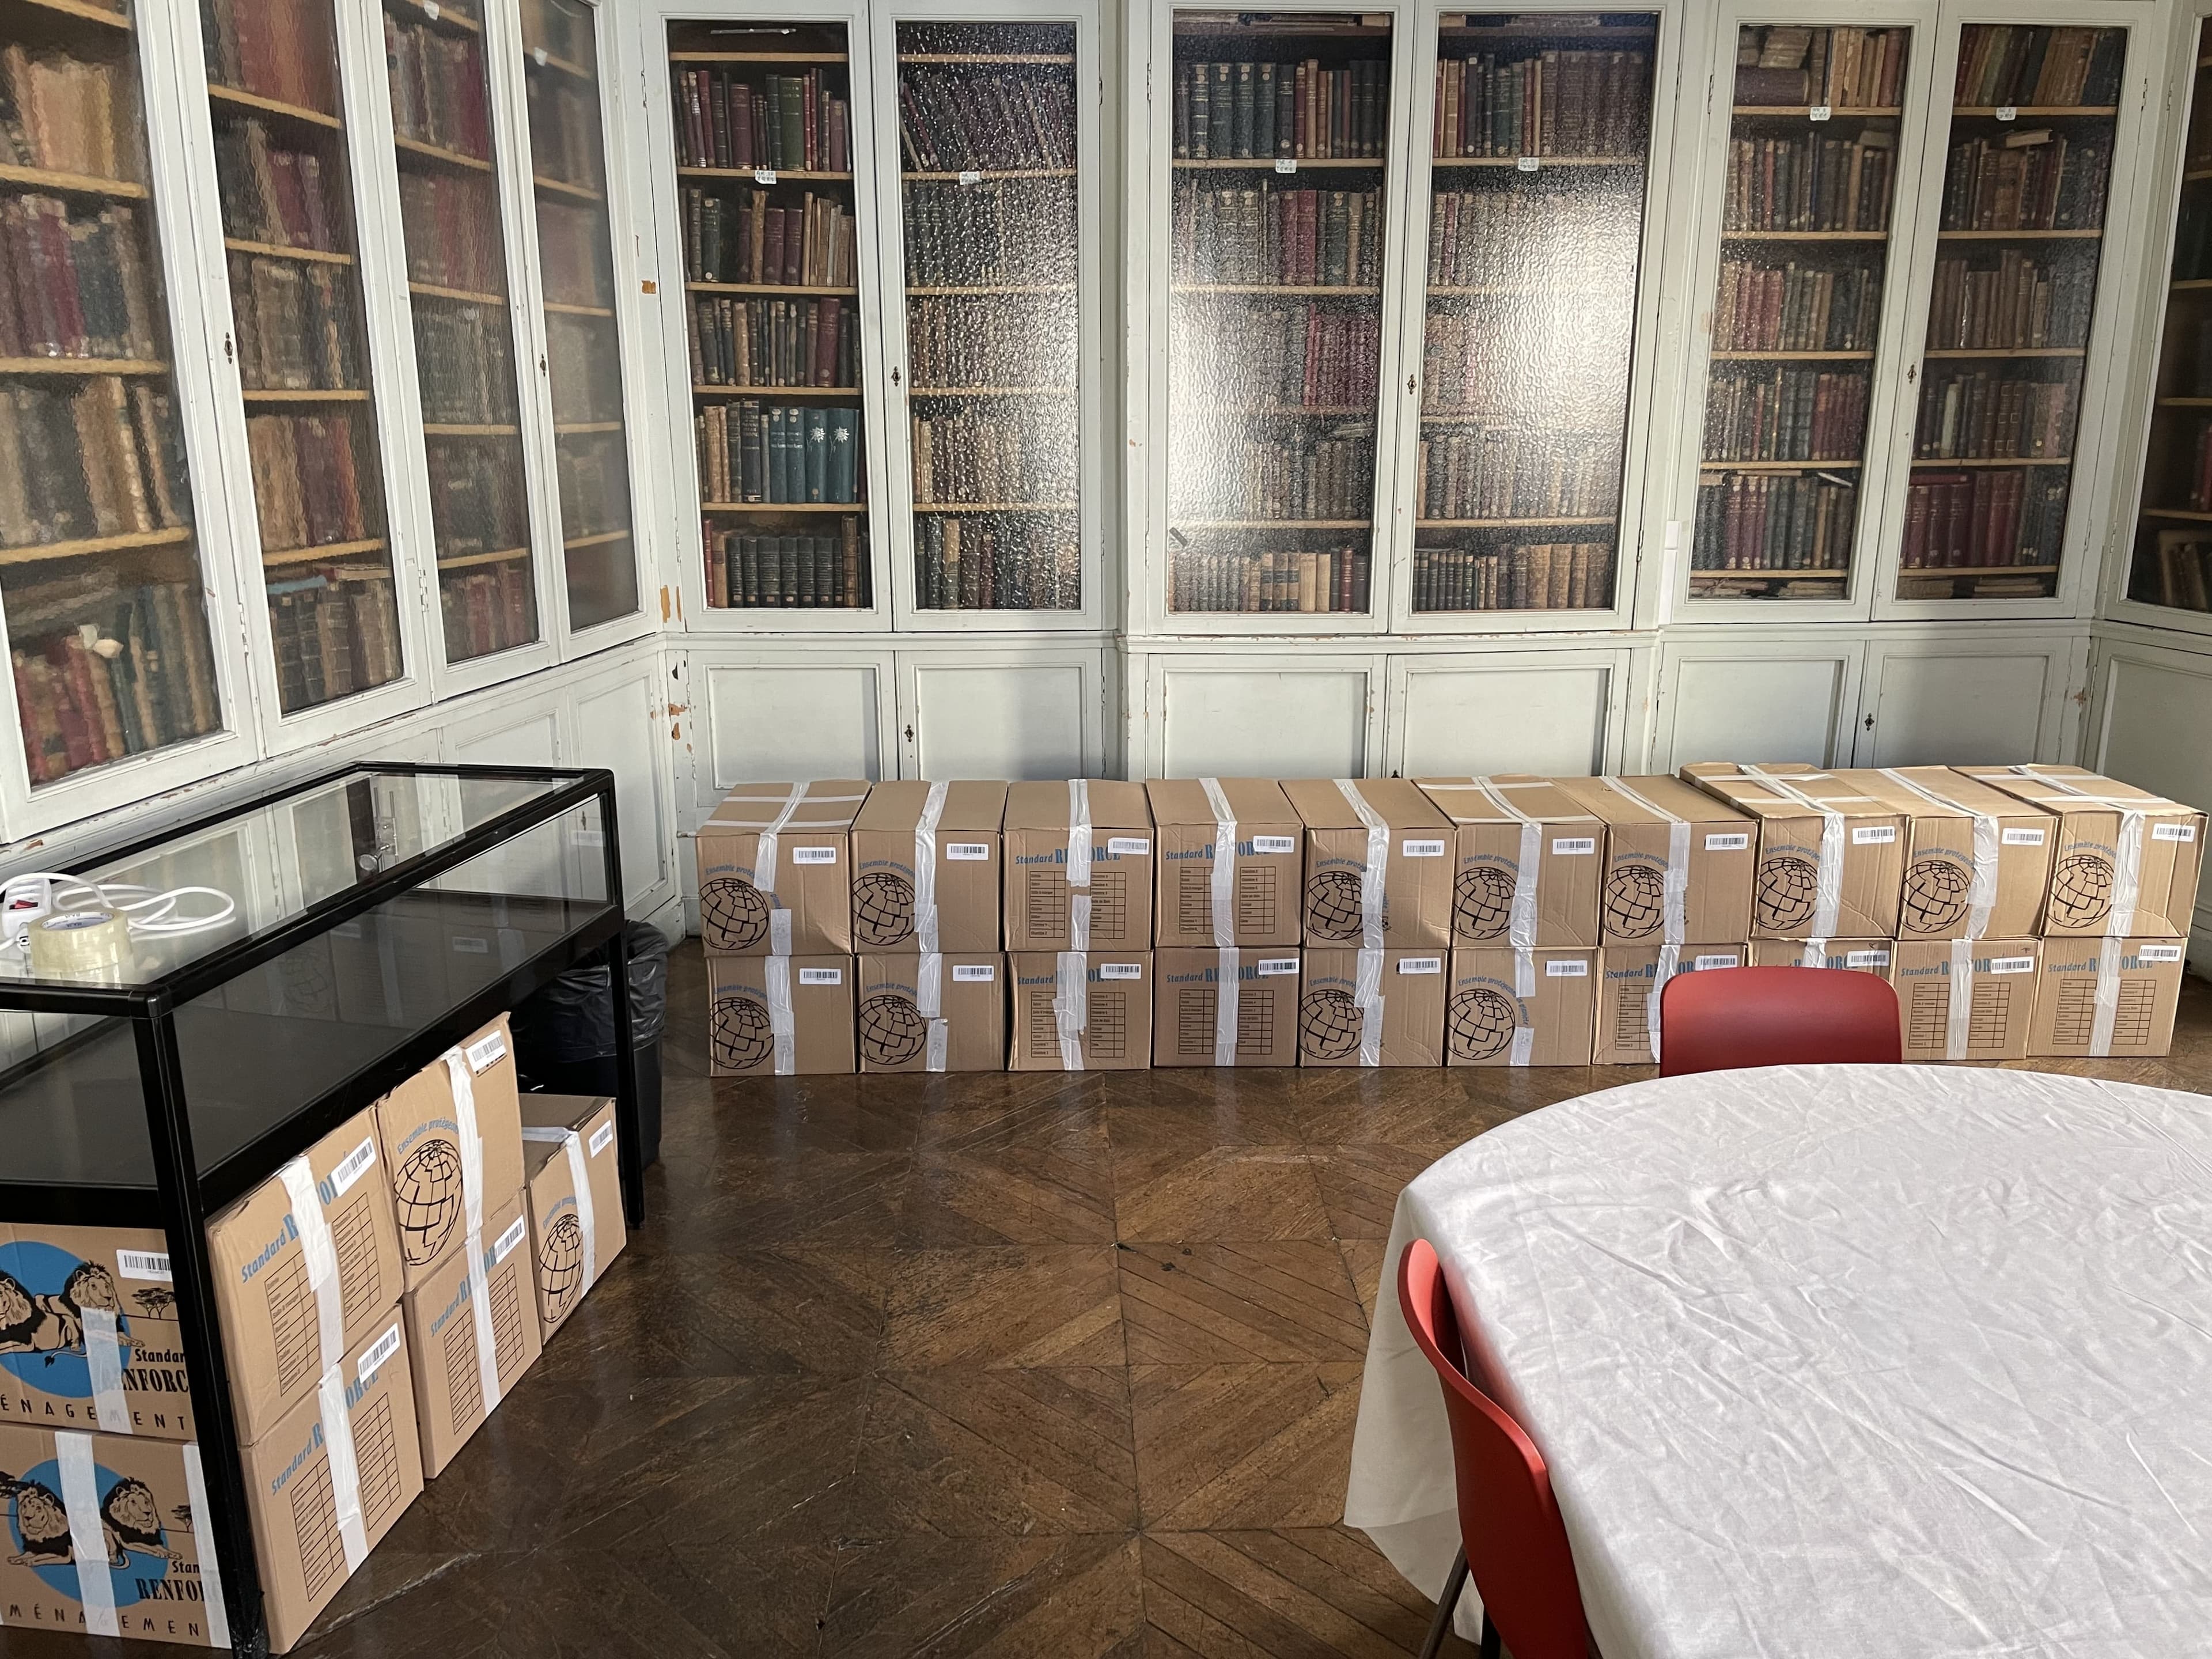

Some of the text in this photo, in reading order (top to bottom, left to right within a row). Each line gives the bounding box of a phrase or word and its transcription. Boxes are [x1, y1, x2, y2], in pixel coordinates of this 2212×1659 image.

[1016, 853, 1053, 865] Standard
[1165, 849, 1203, 860] Standard
[1901, 964, 1939, 977] Standard
[2048, 962, 2086, 972] Standard
[1166, 973, 1203, 983] Standard
[1605, 968, 1643, 979] Standard
[1018, 975, 1054, 985] Standard
[241, 1228, 286, 1284] Standard
[431, 1294, 460, 1337] Standard
[135, 1348, 185, 1363] Standar
[271, 1438, 312, 1496] Standard
